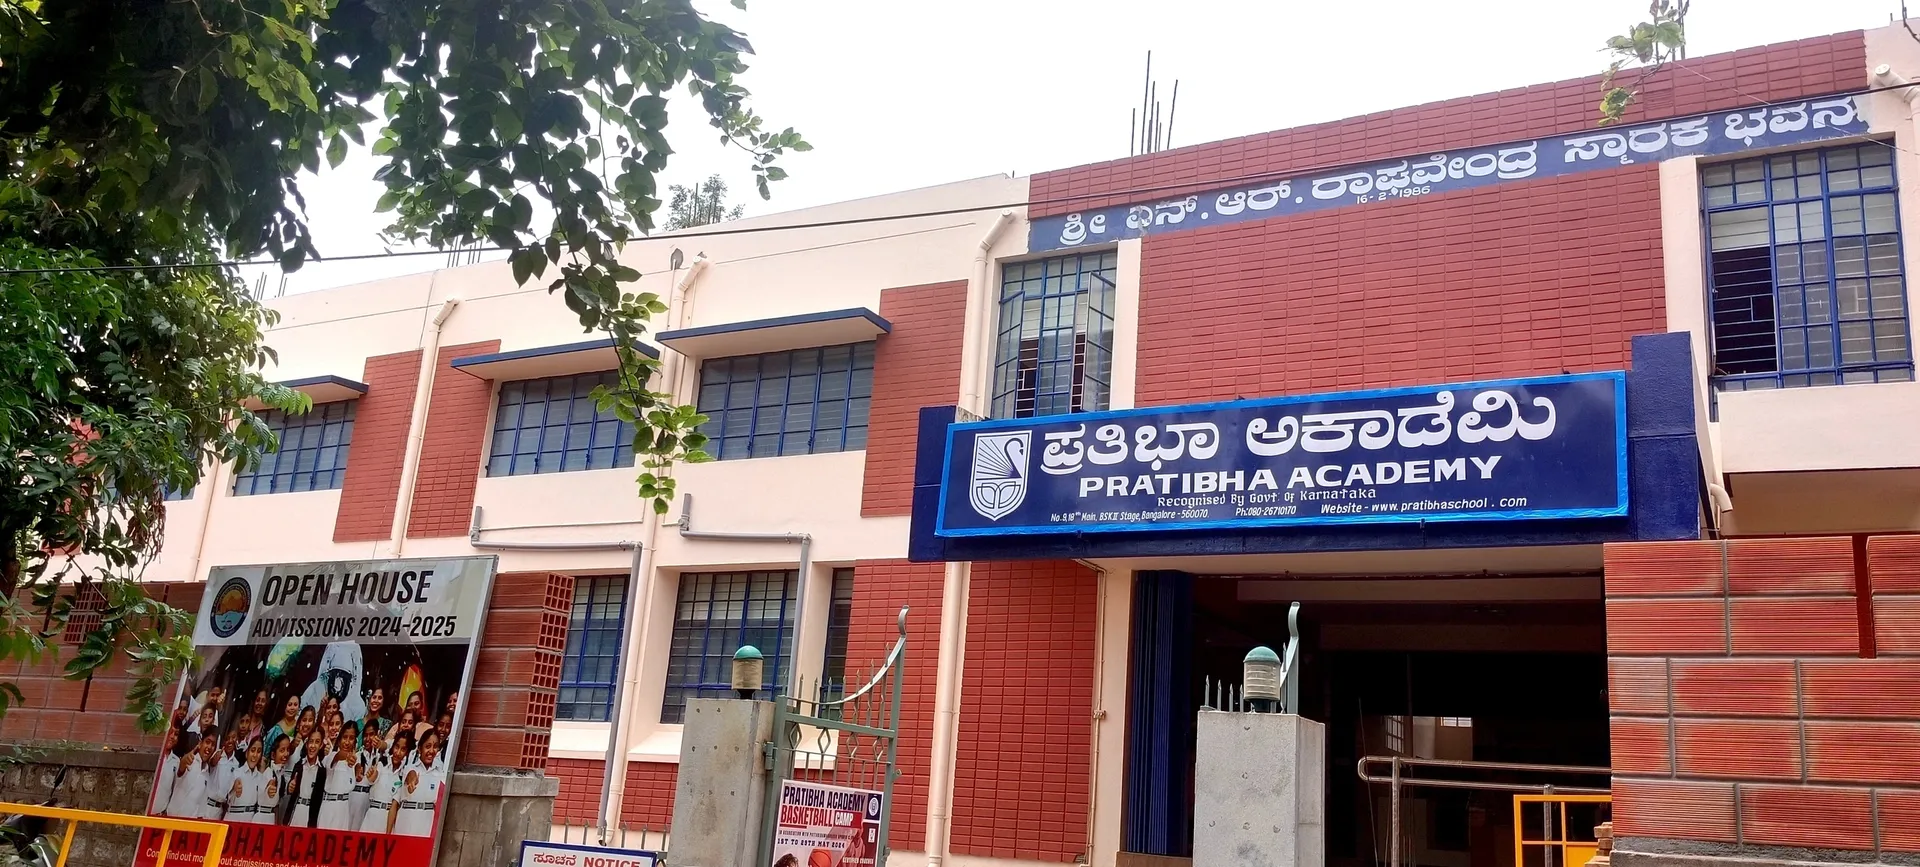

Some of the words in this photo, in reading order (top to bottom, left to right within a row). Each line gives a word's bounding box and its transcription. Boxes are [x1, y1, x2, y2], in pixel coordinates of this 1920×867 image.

[1060, 212, 1107, 245] ಶ್ರೀ
[1311, 140, 1538, 201] ರಾಘವೇಂದ್ರ
[1563, 115, 1709, 165] ಸ್ಮಾರಕ
[1724, 95, 1857, 147] ಭವನ
[1040, 422, 1220, 475] ಪ್ರತಿಭಾ
[1245, 390, 1557, 458] ಅಕಾಡೆಮಿ
[1078, 469, 1278, 498] PRATIBHA
[1286, 455, 1503, 489] ACADEMY
[1157, 493, 1226, 508] Recognised
[1230, 493, 1245, 506] By
[1300, 488, 1376, 501] Karnataka
[1320, 501, 1362, 514] Website
[262, 573, 334, 606] OPEN
[337, 570, 434, 605] HOUSE
[252, 616, 356, 638] ADMISSIONS
[357, 615, 458, 637] 2024-2025
[783, 785, 825, 808] PRATIBHA
[827, 791, 866, 812] ACADEMY
[781, 804, 833, 827] BASKETBALL
[834, 811, 854, 827] CAMP
[271, 831, 398, 867] ACADEMY
